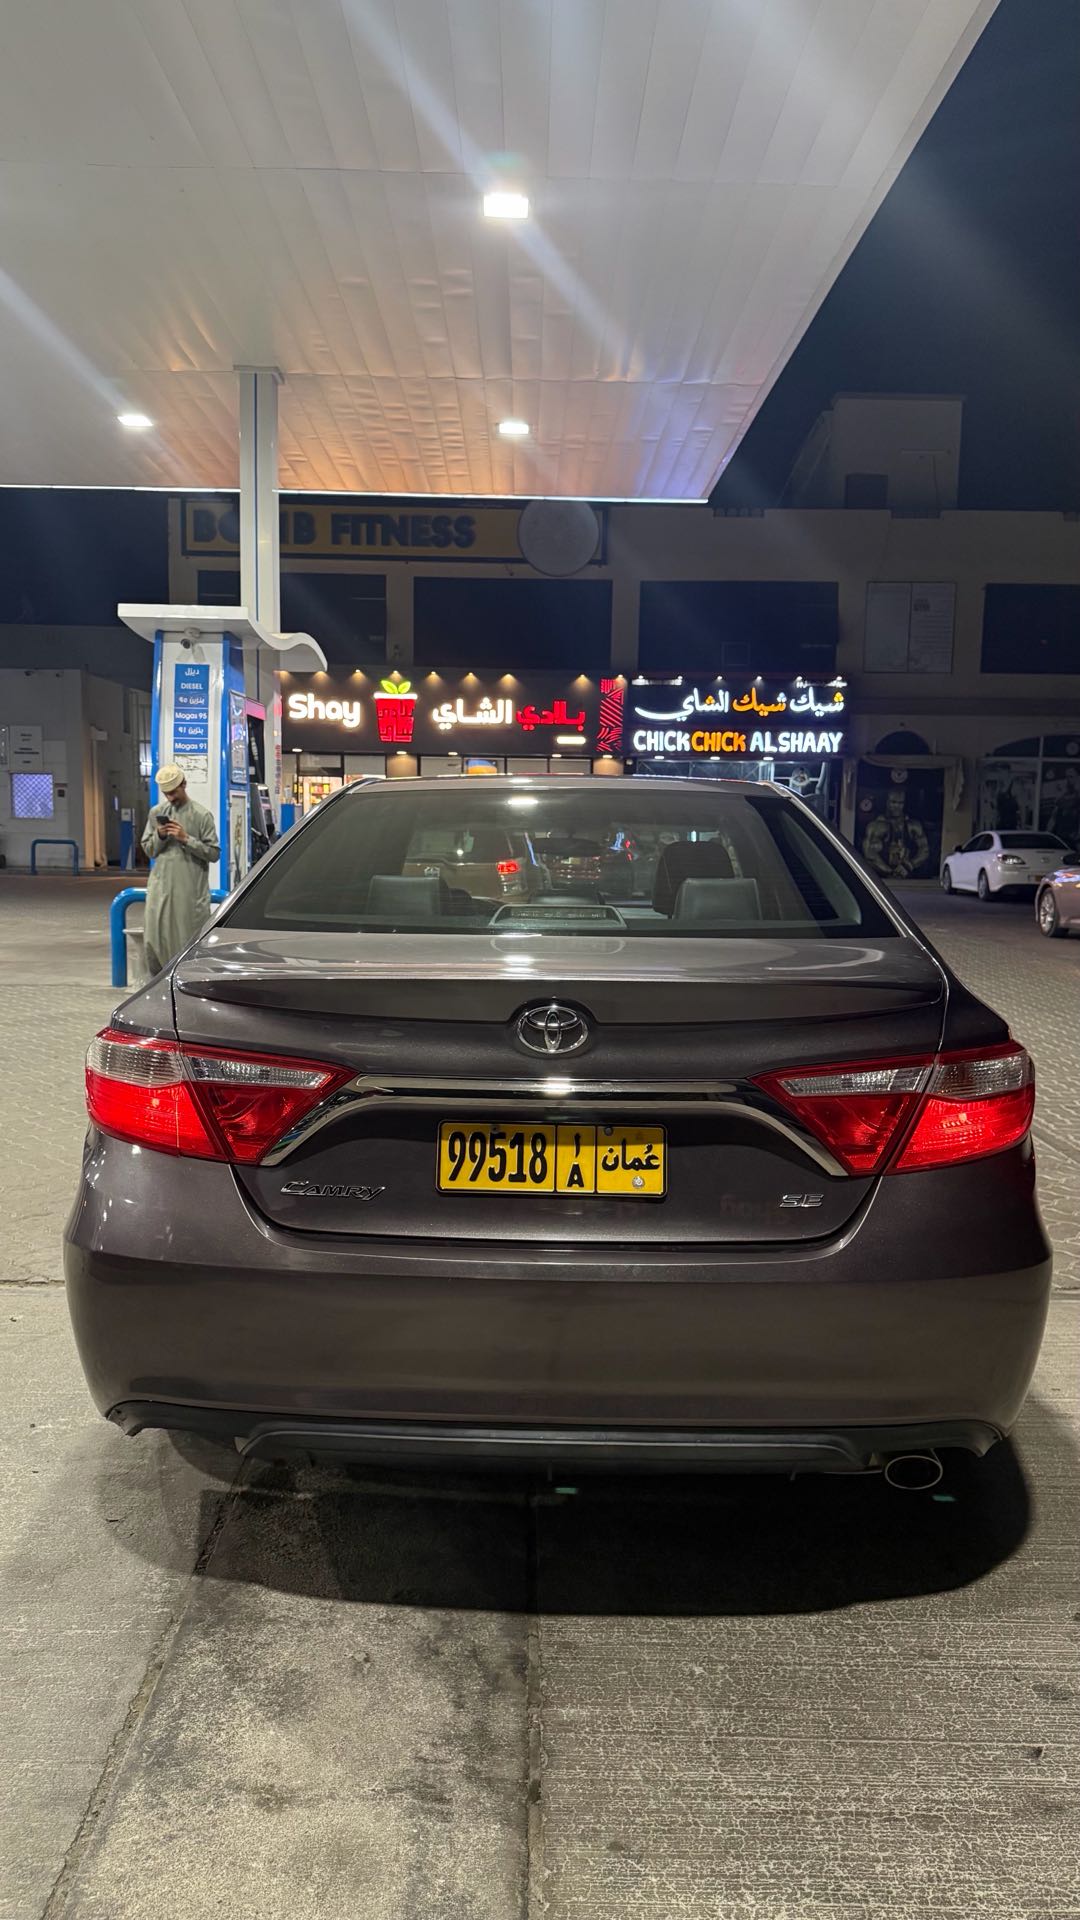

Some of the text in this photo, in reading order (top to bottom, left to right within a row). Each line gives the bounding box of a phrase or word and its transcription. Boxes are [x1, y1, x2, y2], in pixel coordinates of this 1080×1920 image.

[193, 509, 476, 548] BOB FITNESS
[184, 667, 200, 677] ديزل
[180, 682, 203, 690] DIESEL
[189, 696, 205, 705] بنزين
[288, 692, 361, 728] Shay
[634, 686, 845, 721] شيك شيك الشاي
[175, 711, 208, 721] Mogas 95
[432, 697, 513, 730] الشاي
[515, 700, 586, 732] بلادي
[188, 727, 204, 735] بنزين
[633, 729, 691, 752] CHICK
[691, 730, 746, 752] CHICK
[175, 742, 208, 751] Mogas 91
[448, 1130, 548, 1184] 99518
[566, 1163, 585, 1188] A
[280, 1180, 386, 1201] CAMRY
[779, 1193, 824, 1208] SE
